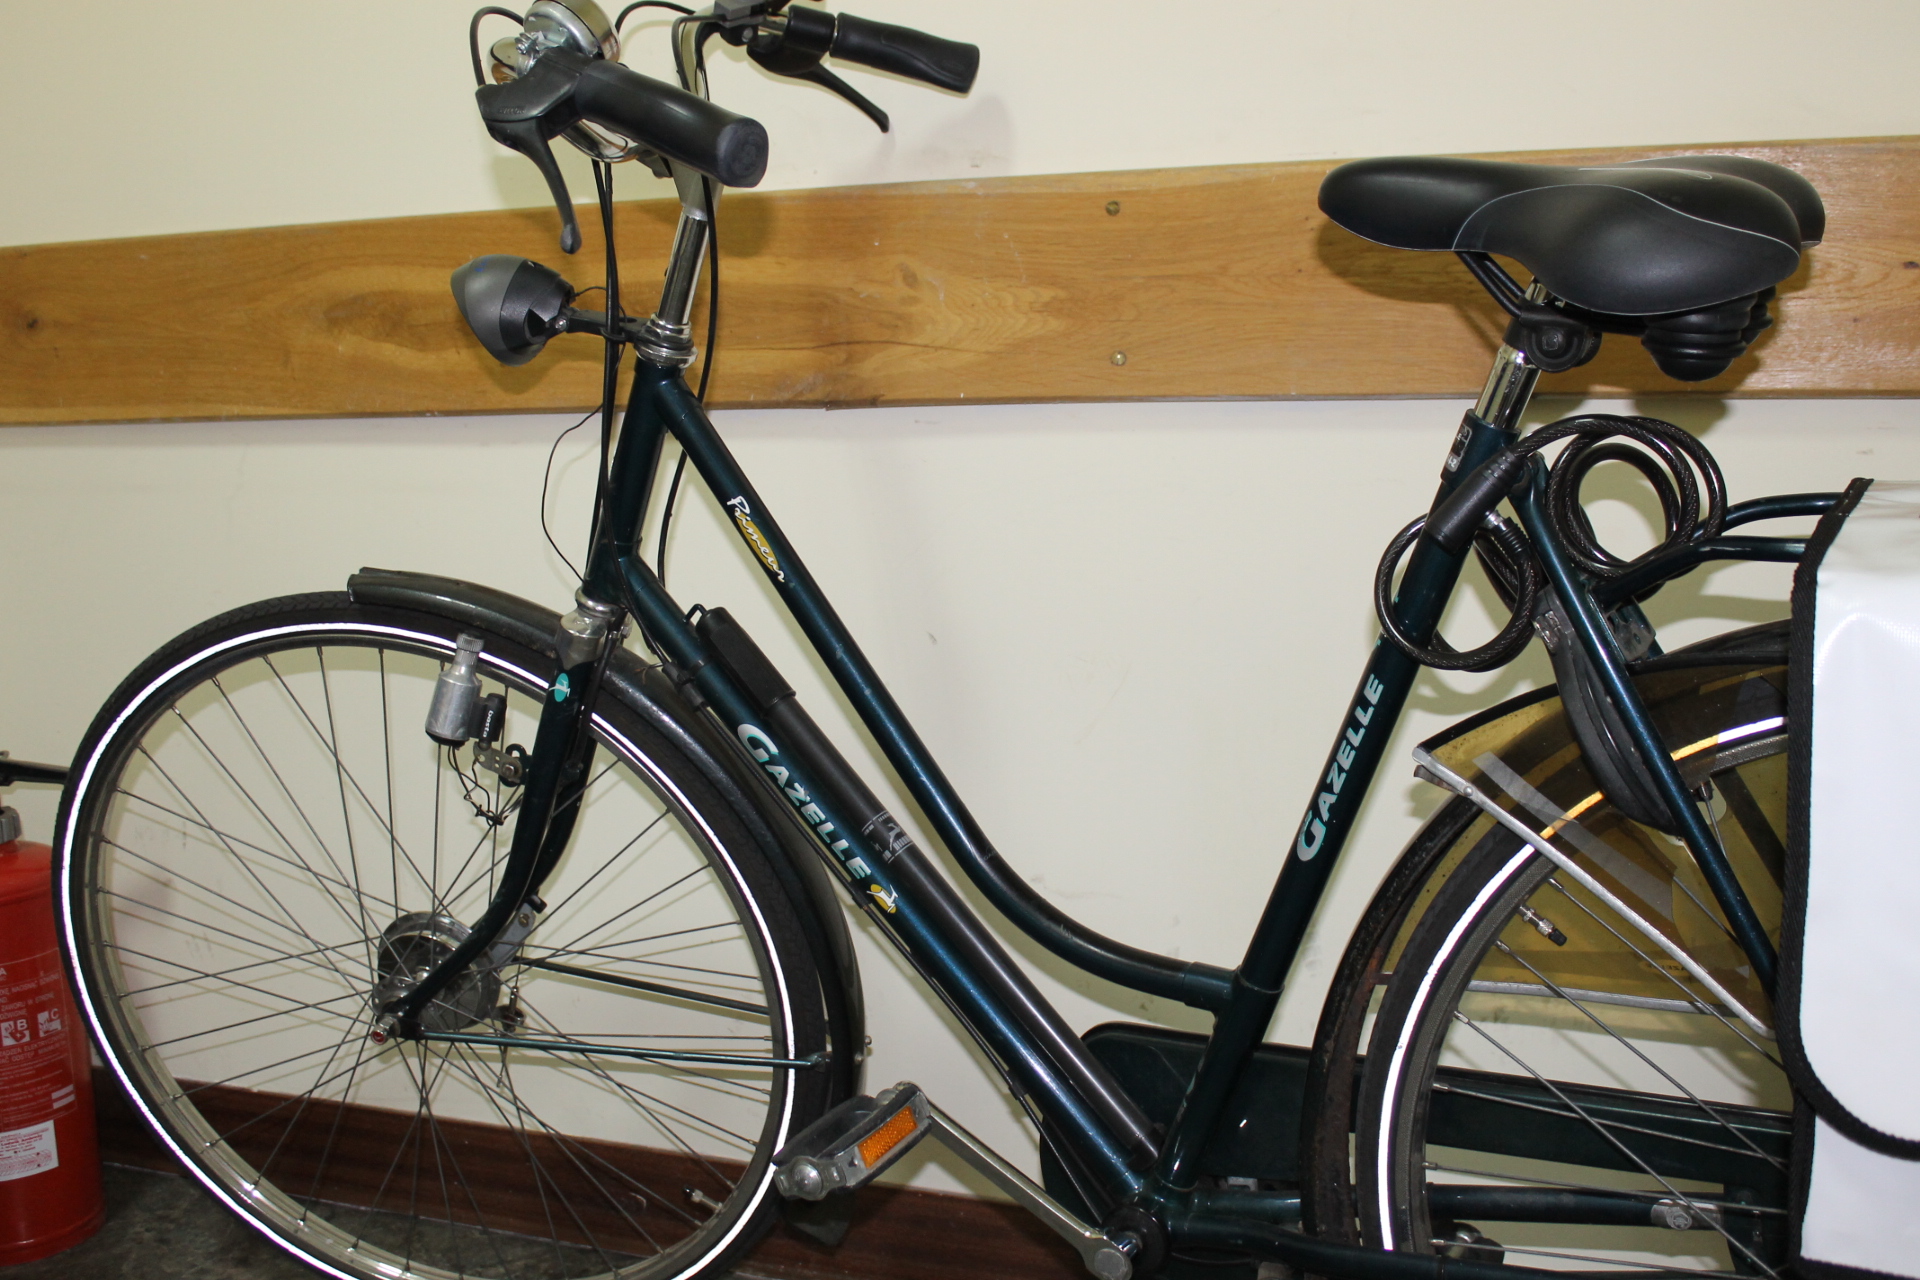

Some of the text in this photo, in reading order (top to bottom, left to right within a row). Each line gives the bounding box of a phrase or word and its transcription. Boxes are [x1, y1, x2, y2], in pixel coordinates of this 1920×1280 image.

[727, 495, 785, 582] Primeur
[482, 709, 494, 738] basta
[737, 723, 872, 880] GAZELLE
[1296, 673, 1384, 862] GAZELLE
[16, 1008, 60, 1031] B C
